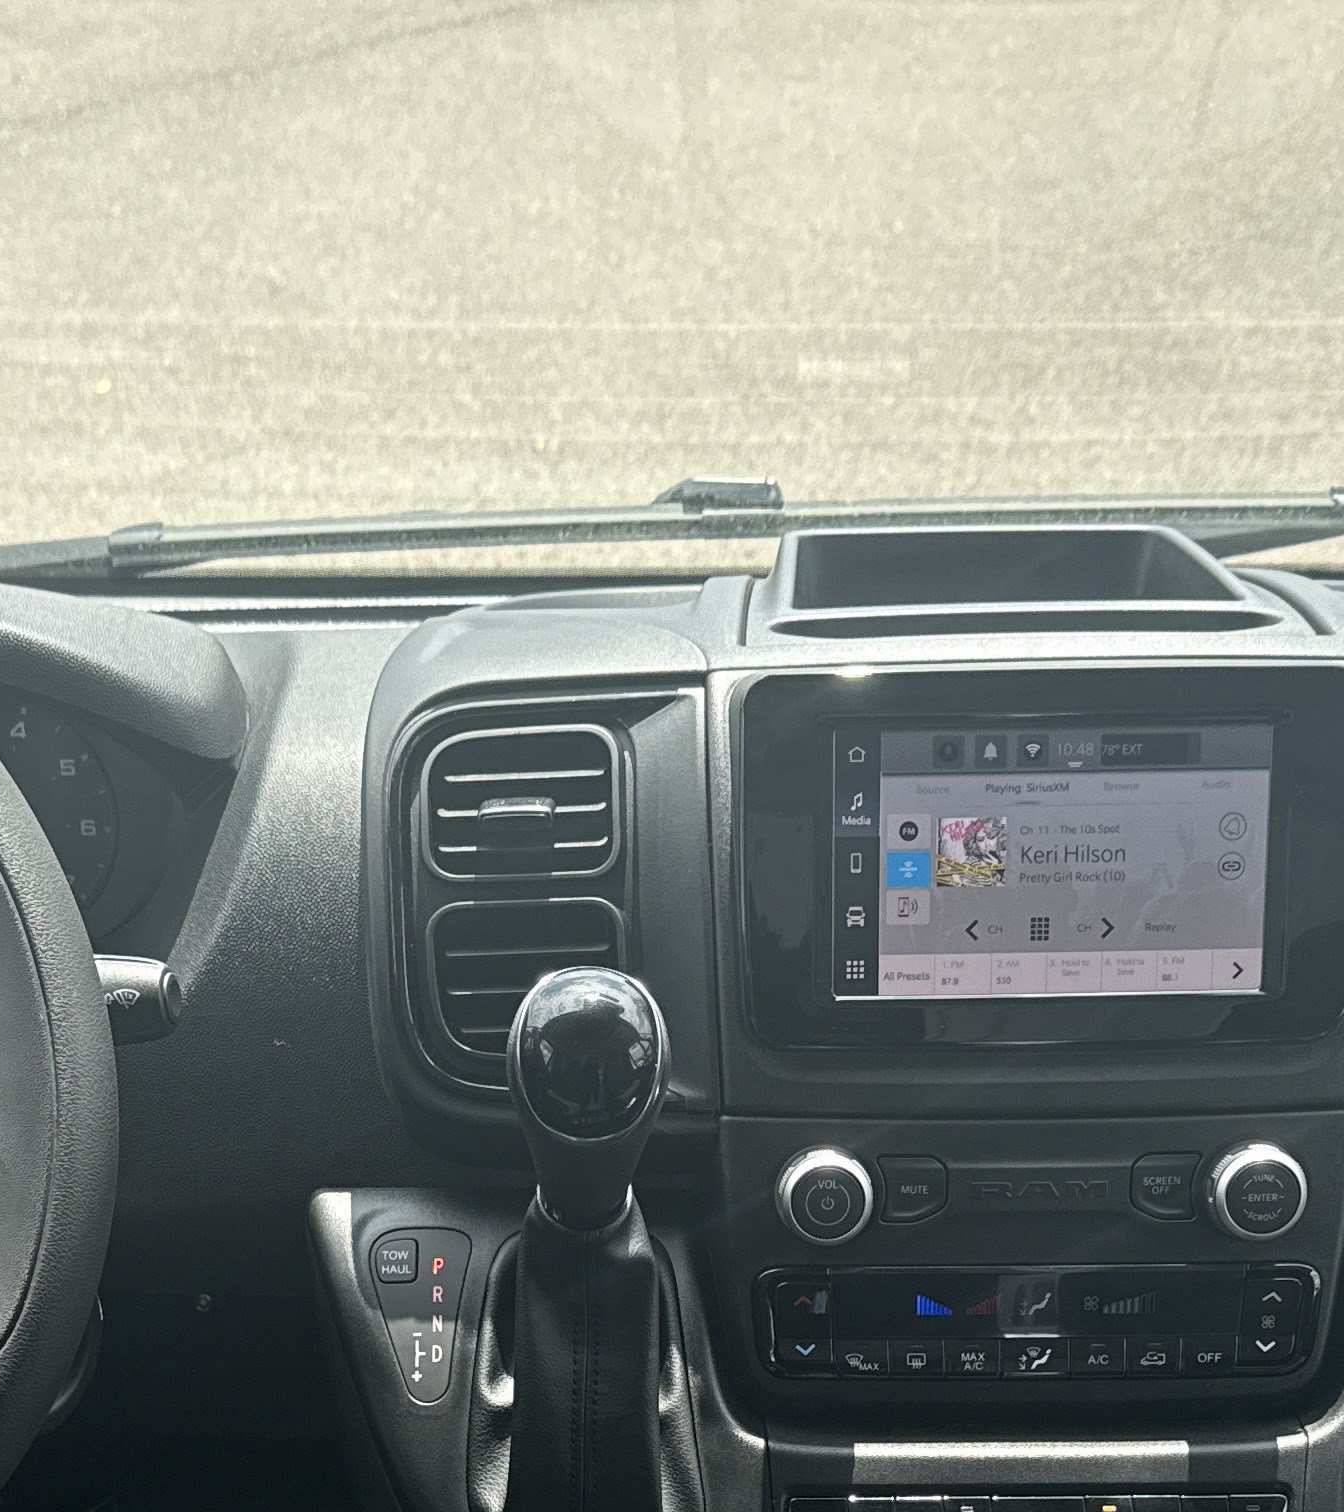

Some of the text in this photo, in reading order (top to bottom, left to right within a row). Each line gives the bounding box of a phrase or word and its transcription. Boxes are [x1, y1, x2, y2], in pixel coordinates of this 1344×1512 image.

[10, 721, 27, 739] 4
[1056, 742, 1094, 757] 10:48
[1122, 744, 1143, 755] EXT
[59, 758, 76, 777] 5
[916, 785, 951, 795] Source
[986, 782, 1070, 795] Playing SiriusXM
[1104, 782, 1140, 792] Browse
[1202, 780, 1231, 790] Audio
[841, 815, 871, 826] Media
[80, 819, 97, 837] 6
[902, 827, 915, 836] FM
[1020, 824, 1121, 836] Ch 11 The 10s Spot
[1021, 844, 1126, 864] Keri Hilson
[1020, 870, 1126, 885] Pretty Girl Rock (10)
[988, 925, 1003, 934] CH
[1077, 923, 1092, 933] CH
[1144, 923, 1177, 934] Replay
[950, 960, 964, 969] FM
[1006, 960, 1020, 968] AM
[1061, 959, 1081, 967] Hold
[1082, 959, 1089, 967] to
[1117, 958, 1135, 966] Hold
[1171, 957, 1185, 965] FM
[1061, 968, 1080, 977] Save
[1117, 967, 1135, 976] Save
[883, 972, 931, 982] All Presets
[1142, 1176, 1181, 1185] SCREEN
[1252, 1175, 1275, 1183] TUNE
[817, 1179, 838, 1190] VOL
[901, 1185, 929, 1195] MUTE
[969, 1178, 1110, 1202] RAM
[1151, 1185, 1170, 1195] OFF
[1248, 1194, 1278, 1202] ENTER
[1247, 1211, 1279, 1222] SCROLL
[382, 1250, 409, 1260] TOW
[381, 1265, 412, 1274] HAUL
[432, 1257, 444, 1275] P
[432, 1286, 443, 1303] R
[432, 1315, 443, 1333] N
[431, 1345, 443, 1363] D
[960, 1352, 985, 1362] MAX
[1197, 1352, 1222, 1363] OFF
[1087, 1354, 1109, 1365] A/C
[859, 1362, 880, 1371] MAX
[964, 1361, 984, 1370] A/C
